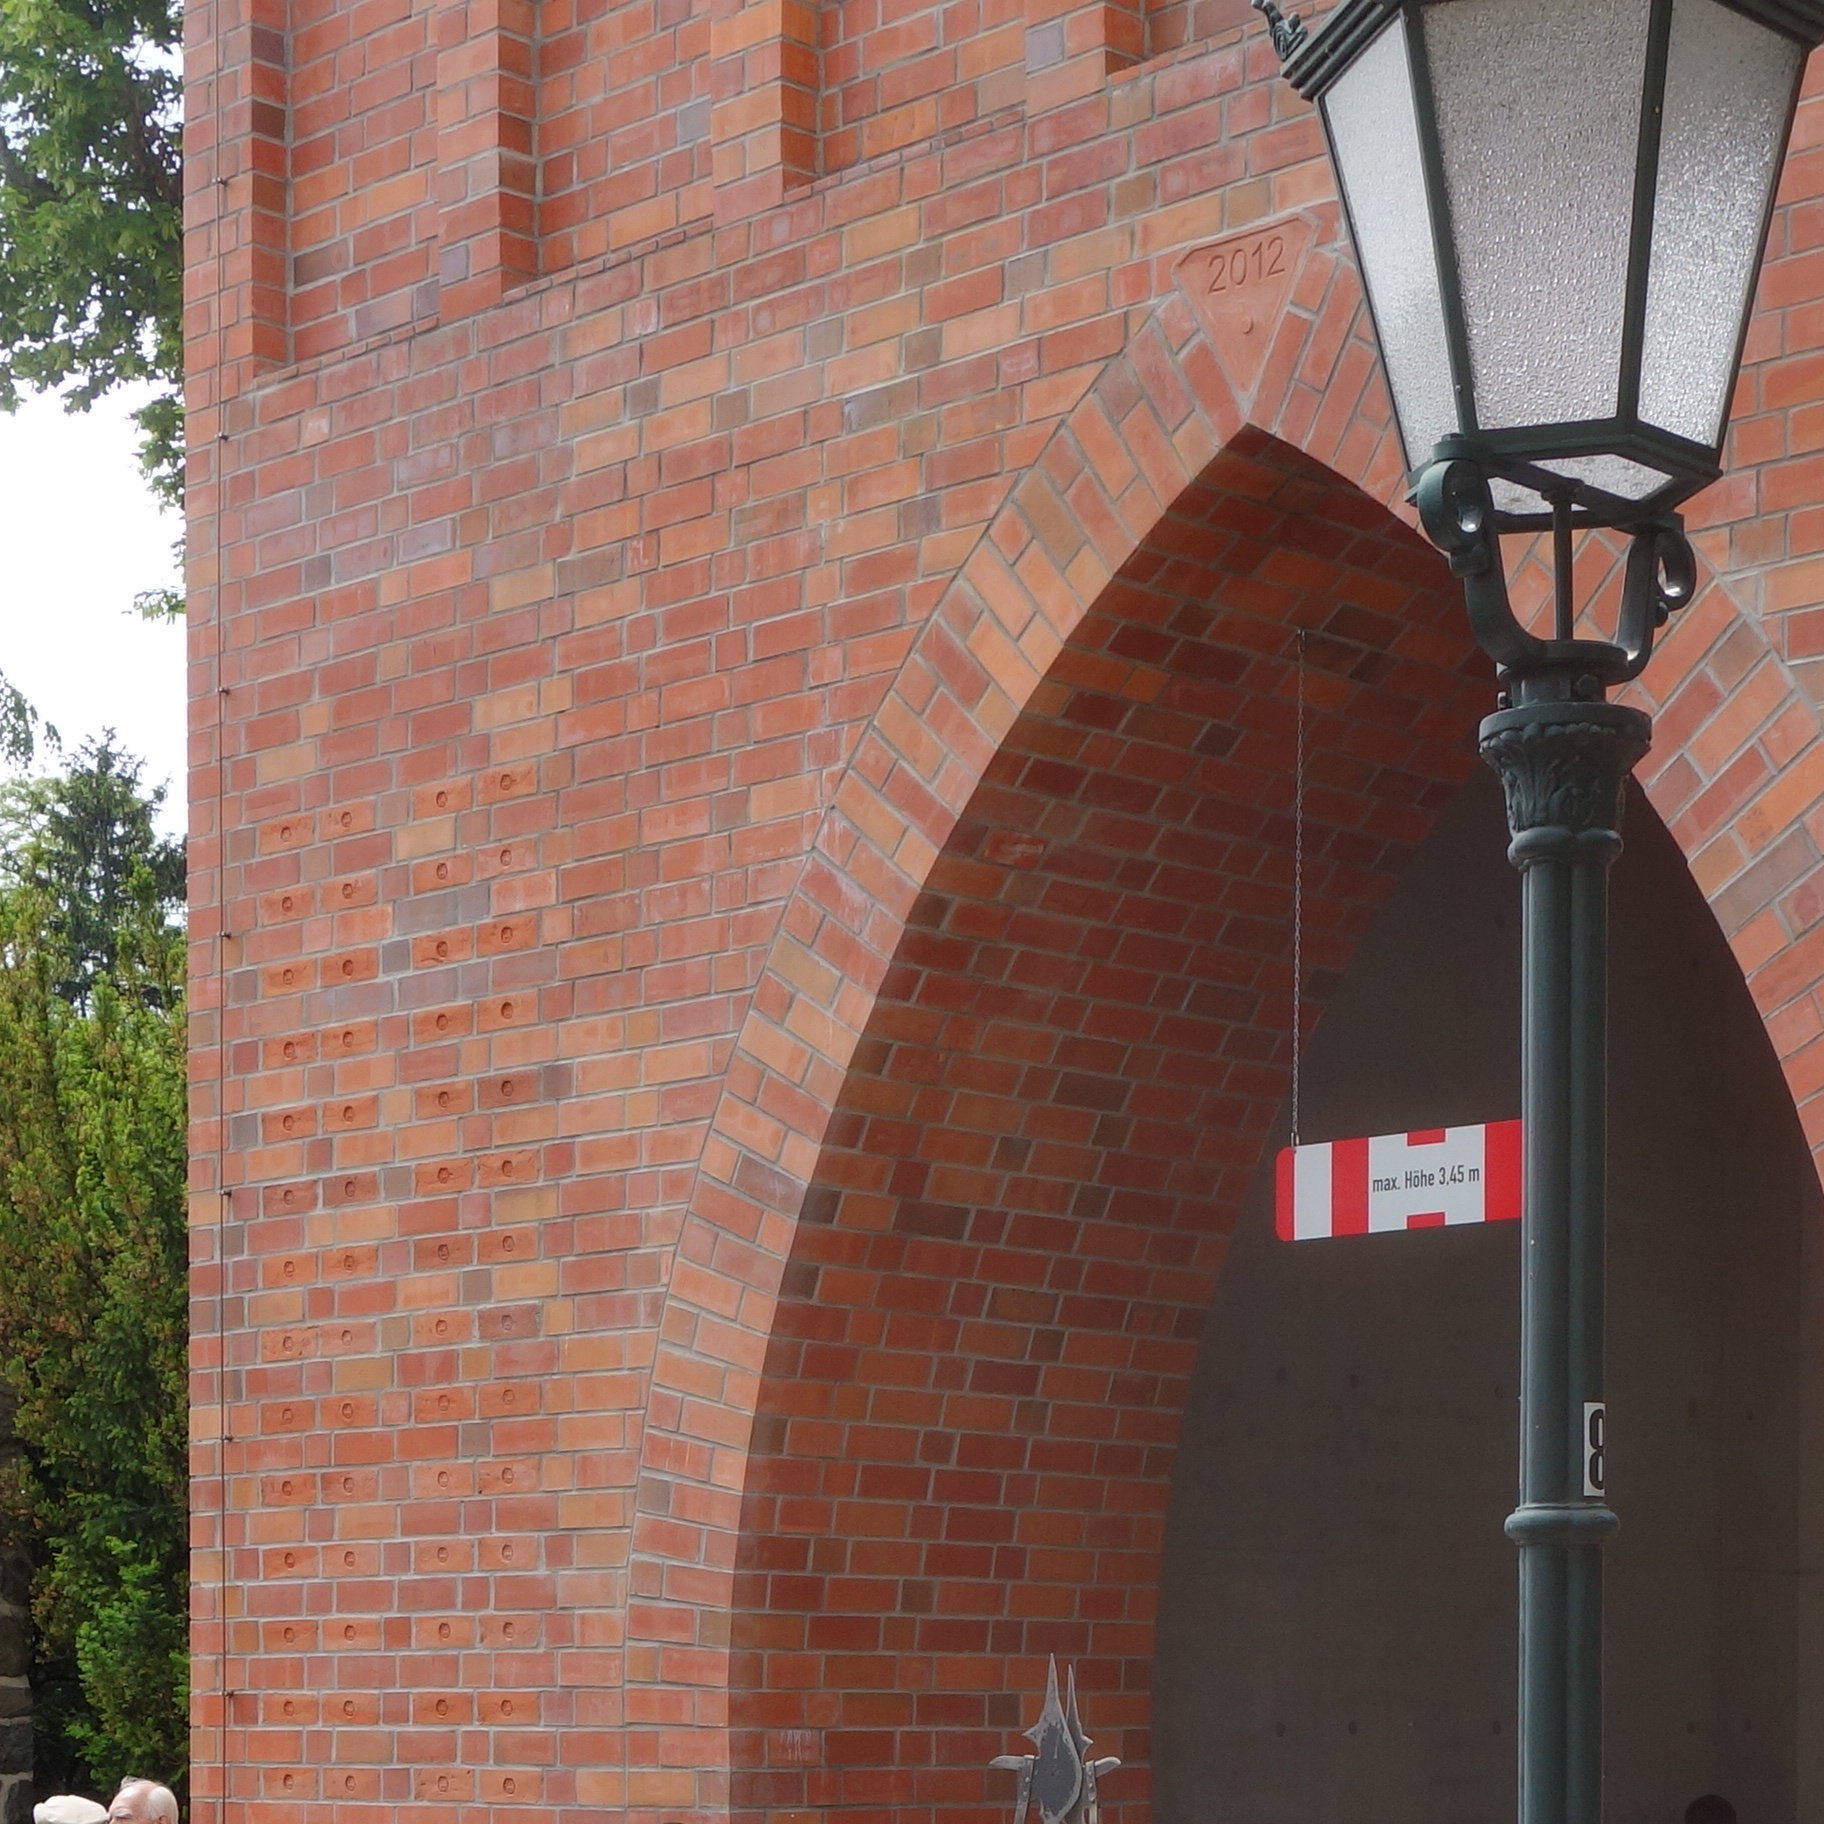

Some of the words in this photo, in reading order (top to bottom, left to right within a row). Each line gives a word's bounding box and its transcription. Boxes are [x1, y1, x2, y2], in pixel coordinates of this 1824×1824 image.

[1207, 236, 1286, 295] 2012
[1372, 1176, 1401, 1193] max.
[1404, 1168, 1435, 1190] Höhe
[1438, 1164, 1465, 1187] 3,45
[1468, 1167, 1480, 1183] m
